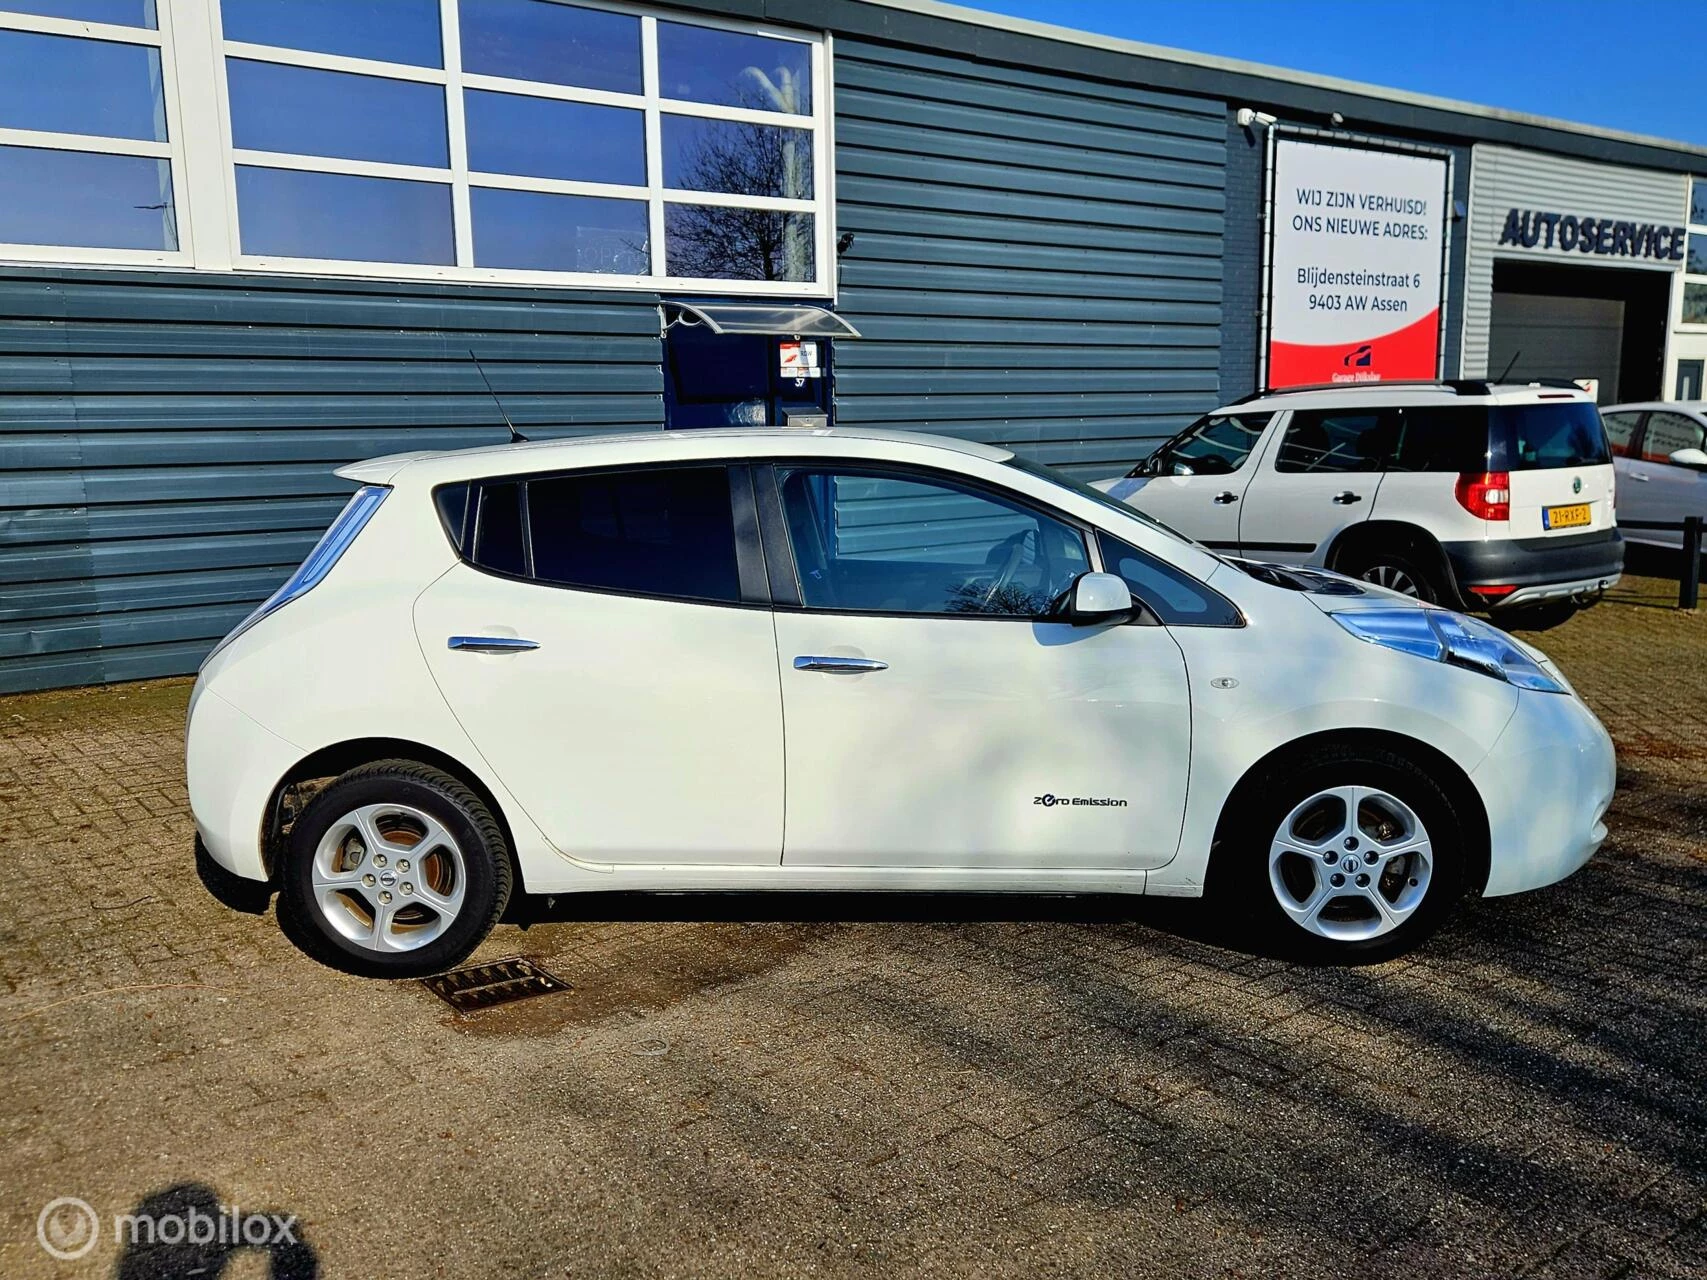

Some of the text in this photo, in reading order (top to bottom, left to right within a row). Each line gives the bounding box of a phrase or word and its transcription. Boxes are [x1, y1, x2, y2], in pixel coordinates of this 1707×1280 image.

[1296, 188, 1427, 216] WIJ ZIJN VERHUISD!
[1292, 215, 1428, 240] ONS NIEUWE ADRES:
[1498, 208, 1687, 261] AUTOSERVICE
[1297, 267, 1421, 288] Blijdensteinstraat 6
[1308, 294, 1408, 311] 9403 AW Assen
[795, 378, 805, 387] 37
[1072, 797, 1128, 807] Emission
